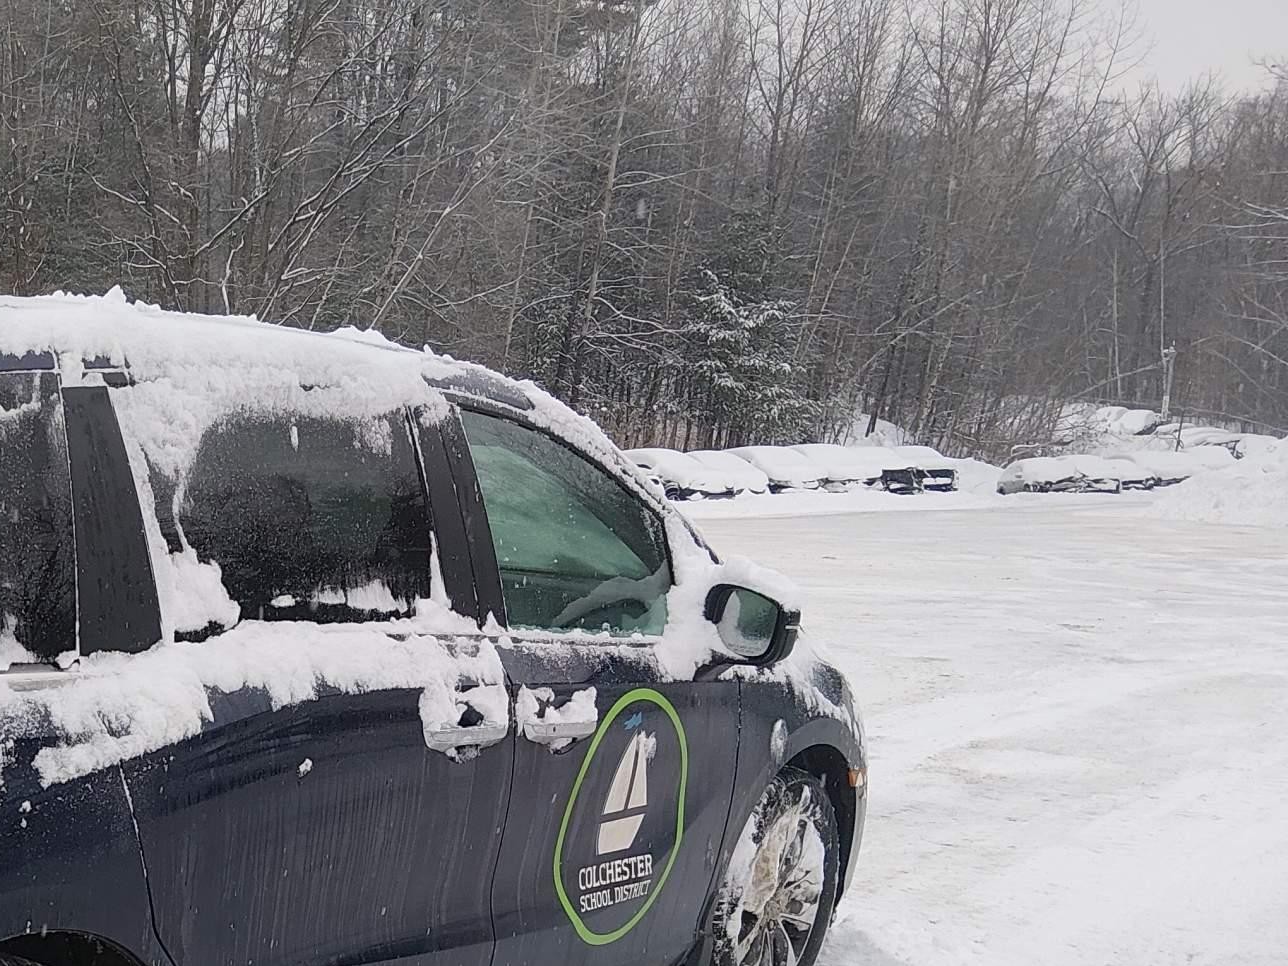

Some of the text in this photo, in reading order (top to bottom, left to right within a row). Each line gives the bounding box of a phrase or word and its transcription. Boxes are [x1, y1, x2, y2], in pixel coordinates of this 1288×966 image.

[578, 853, 653, 891] COLCHESTER
[579, 879, 652, 913] SCHOOL DISTRICT
